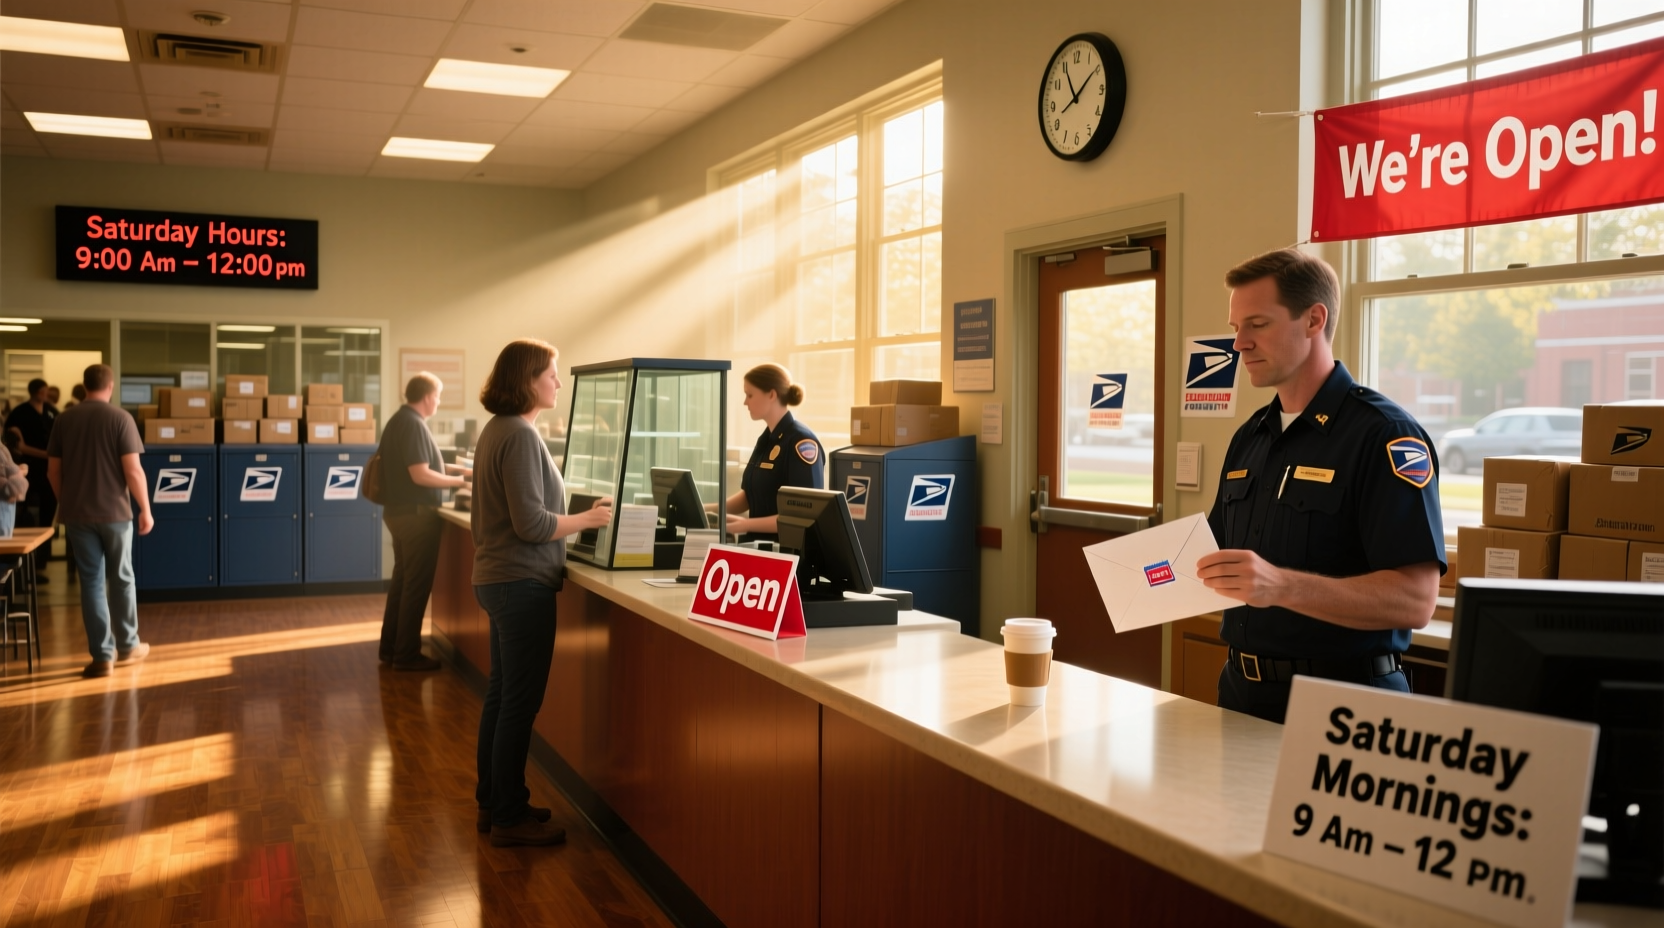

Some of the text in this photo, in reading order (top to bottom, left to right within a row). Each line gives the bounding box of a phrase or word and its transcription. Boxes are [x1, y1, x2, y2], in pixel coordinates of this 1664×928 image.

[1073, 50, 1081, 64] 12
[1050, 100, 1056, 113] 9
[1338, 88, 1658, 199] We’re Open!
[87, 214, 286, 249] Saturday Hours:
[75, 246, 132, 271] 9:00
[140, 251, 176, 273] Am
[207, 252, 273, 277] 12:00
[276, 262, 306, 281] pm
[704, 558, 781, 615] Open
[1325, 706, 1530, 792] Saturday
[1311, 753, 1533, 842] Mornings:
[1292, 803, 1314, 837] 9
[1319, 815, 1374, 856] Am
[1414, 835, 1457, 880] 12
